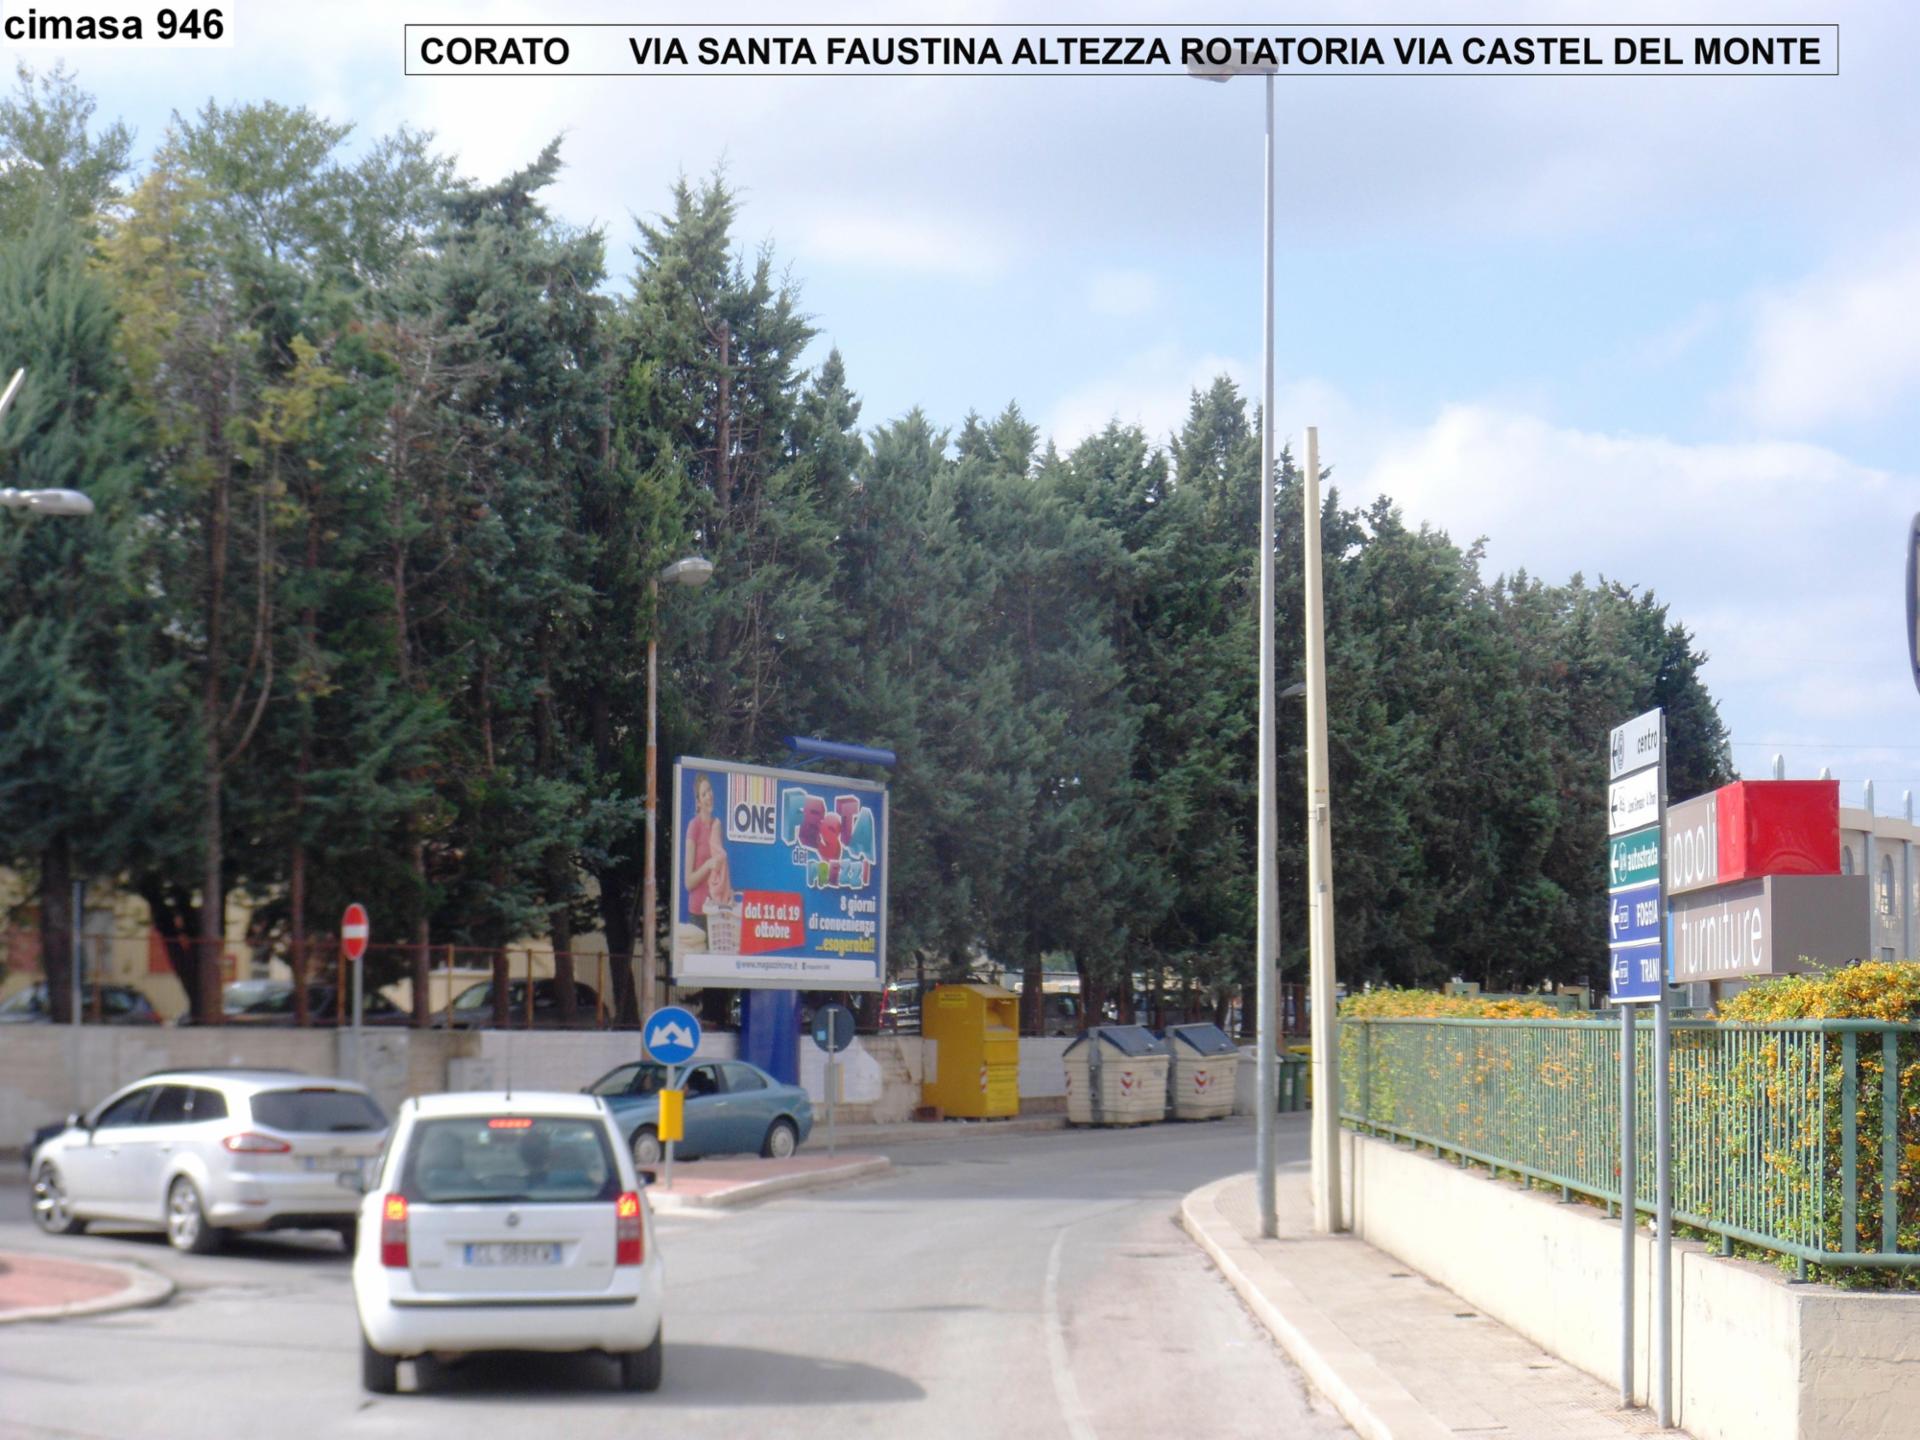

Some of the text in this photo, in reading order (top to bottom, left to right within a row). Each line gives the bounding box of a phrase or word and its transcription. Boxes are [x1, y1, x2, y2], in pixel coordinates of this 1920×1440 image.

[1637, 728, 1658, 755] centro
[734, 803, 775, 834] ONE
[1627, 841, 1658, 872] autostrada
[744, 903, 761, 919] dal
[776, 905, 787, 921] al
[788, 905, 800, 921] 19
[840, 894, 876, 919] 8 giorni
[1636, 899, 1659, 928] FOGGIA
[754, 921, 790, 939] ottobre
[808, 912, 876, 937] di convenienza
[1681, 902, 1763, 974] furniture
[1640, 958, 1660, 983] TRANI
